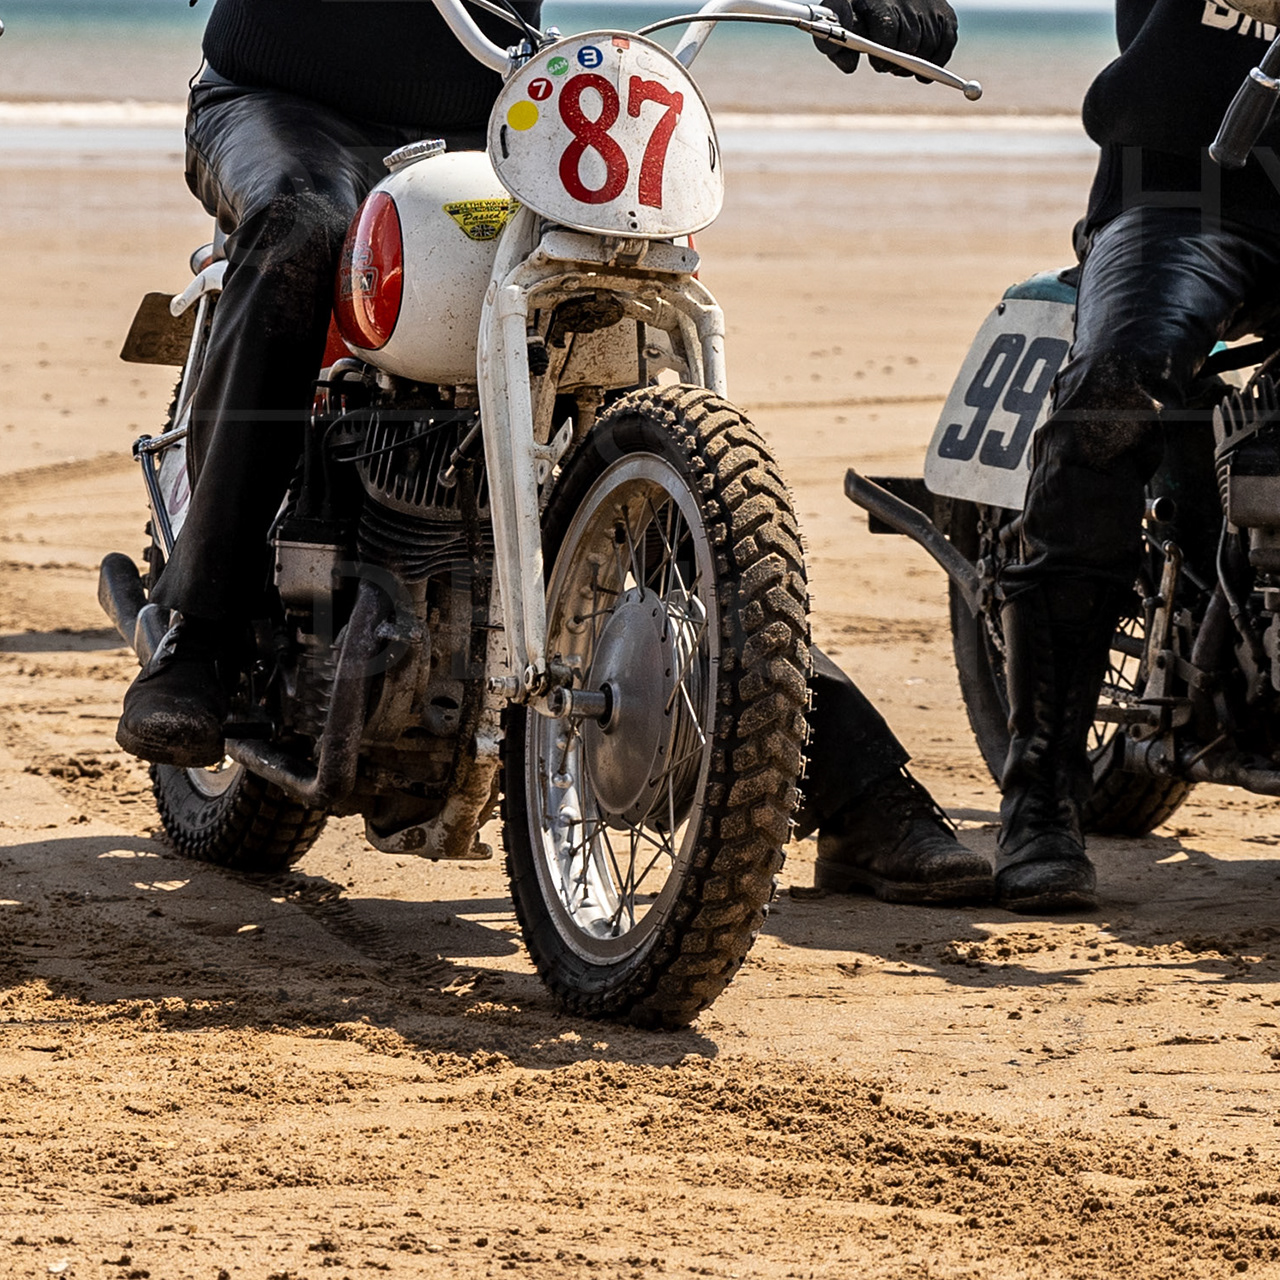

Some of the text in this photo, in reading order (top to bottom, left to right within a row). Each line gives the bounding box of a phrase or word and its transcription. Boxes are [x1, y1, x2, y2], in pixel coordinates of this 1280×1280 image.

[547, 59, 568, 73] SAM
[582, 49, 598, 66] 3
[533, 80, 547, 98] 7
[558, 73, 684, 209] 87
[938, 332, 1068, 470] 99
